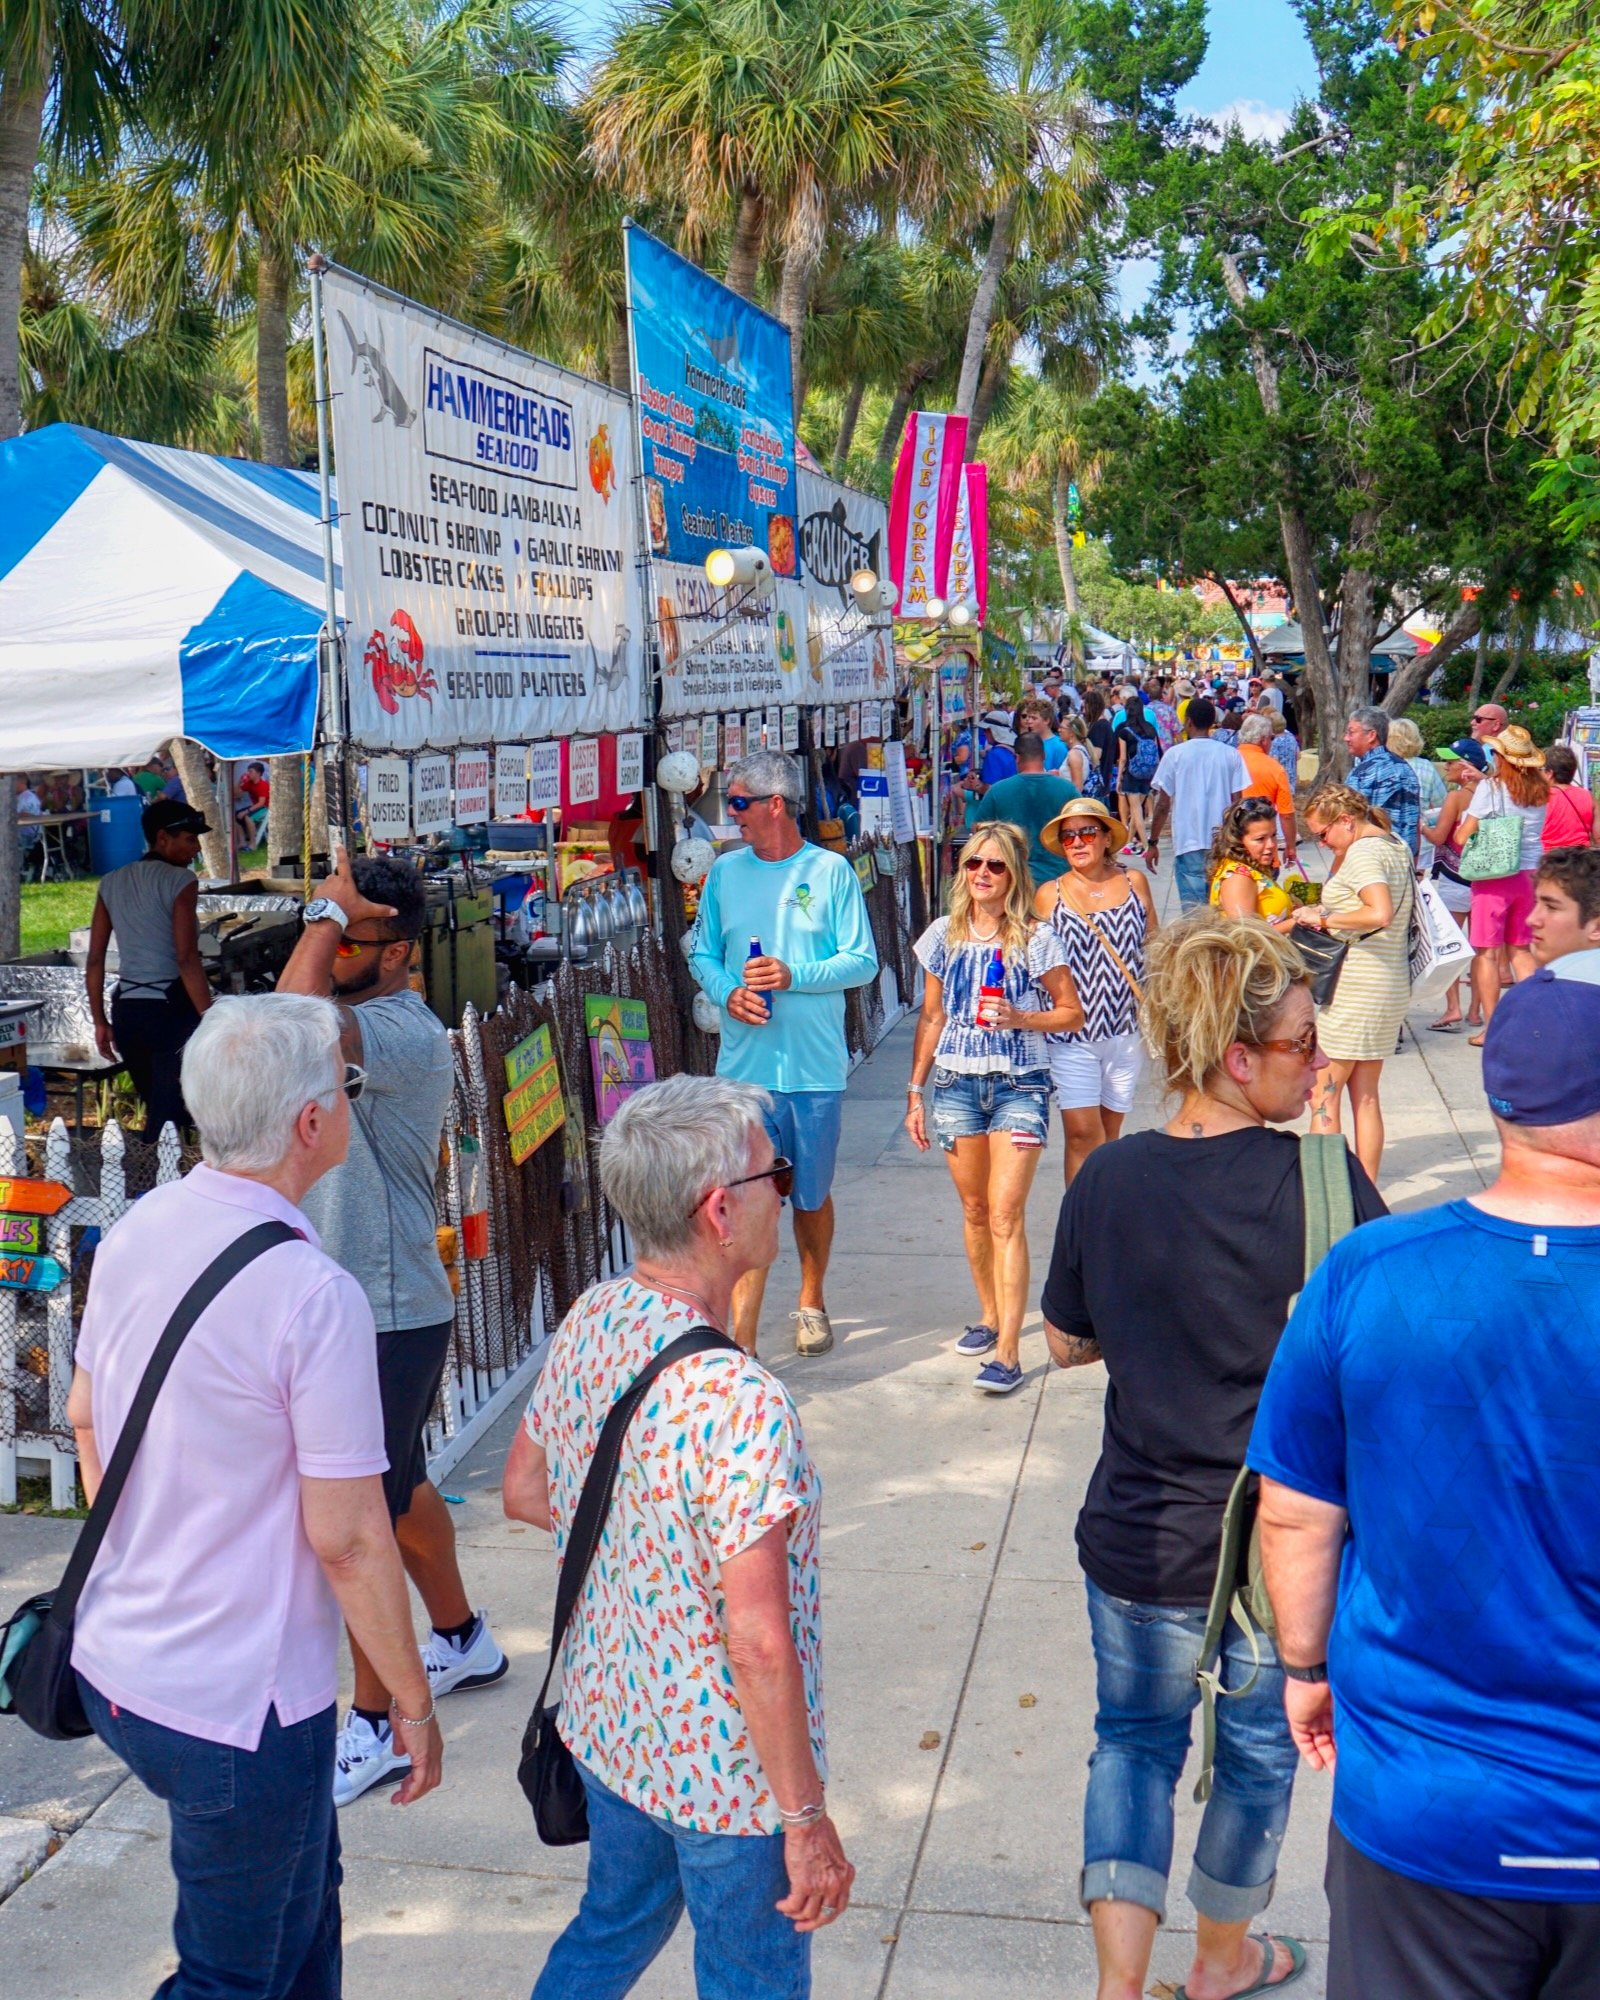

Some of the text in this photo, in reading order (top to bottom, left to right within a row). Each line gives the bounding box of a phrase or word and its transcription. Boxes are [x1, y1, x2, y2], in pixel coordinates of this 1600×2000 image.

[427, 362, 571, 451] HAMMERHEADS
[668, 391, 695, 427] Cakes
[477, 432, 538, 471] SEAFOOD
[669, 421, 697, 464] Shrimp
[919, 425, 937, 488] ICE
[759, 455, 789, 490] Shrimp
[430, 473, 582, 530] SEAFOOD JAMBALAYA
[362, 501, 439, 545] COCONUT
[447, 521, 501, 556] SHRIMP
[528, 537, 574, 567] GARLIC
[681, 503, 718, 540] Seafood
[803, 517, 870, 582] GROUPER
[907, 500, 928, 604] CREAM
[380, 546, 593, 600] LOBSTER CAKES SCALLOPS
[455, 608, 584, 640] GROUPER NUGGETS
[447, 671, 586, 699] SEAFOOD PLATTERS
[458, 762, 487, 790] GROUPER
[499, 757, 524, 777] SEAFOOD
[533, 748, 558, 772] GROUPER
[378, 773, 400, 793] FRIED
[420, 765, 446, 792] SEAFOOD
[498, 782, 525, 802] PLATTERS
[532, 775, 558, 801] NUGGETS
[372, 802, 406, 823] OYSTERS
[459, 796, 487, 814] SANDWICH
